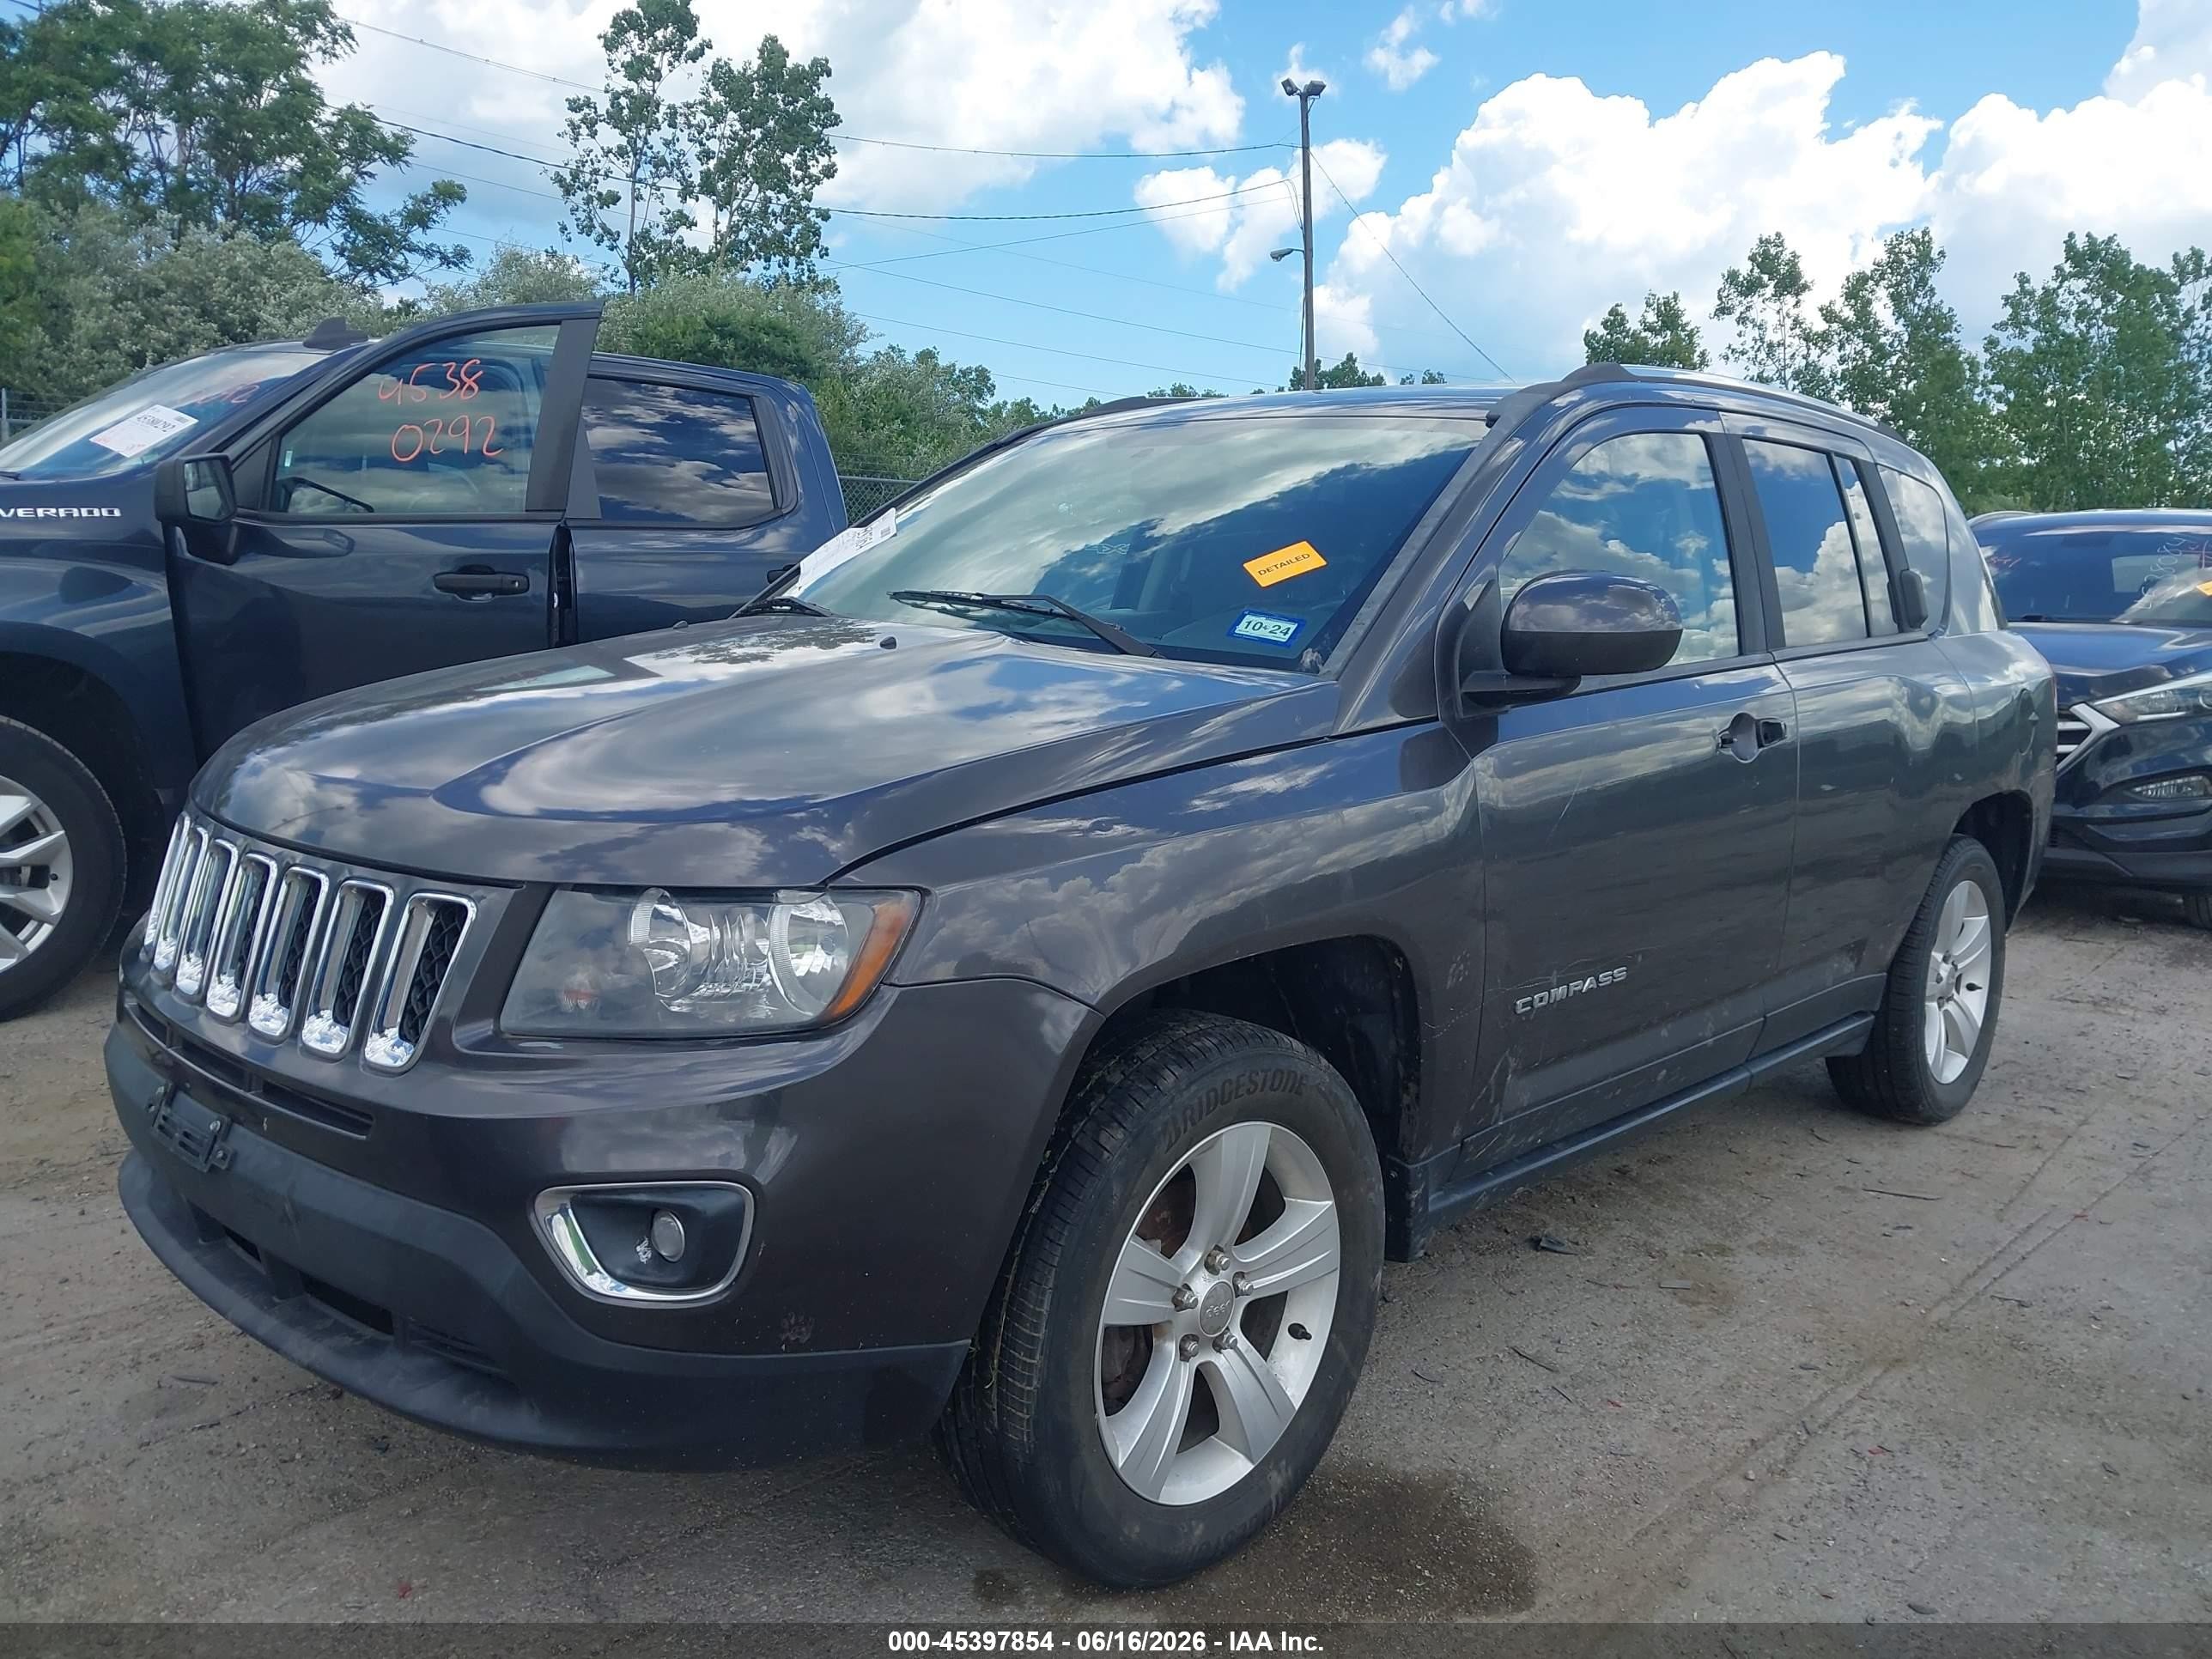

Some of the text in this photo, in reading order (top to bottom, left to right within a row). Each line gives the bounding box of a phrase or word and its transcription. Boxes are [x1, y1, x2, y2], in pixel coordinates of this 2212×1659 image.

[378, 357, 484, 406] 4538
[392, 414, 505, 462] 0292
[1257, 552, 1311, 576] DETAILED
[1516, 966, 1628, 1015] COMPASS
[1163, 1067, 1308, 1155] BRIDGESTONE
